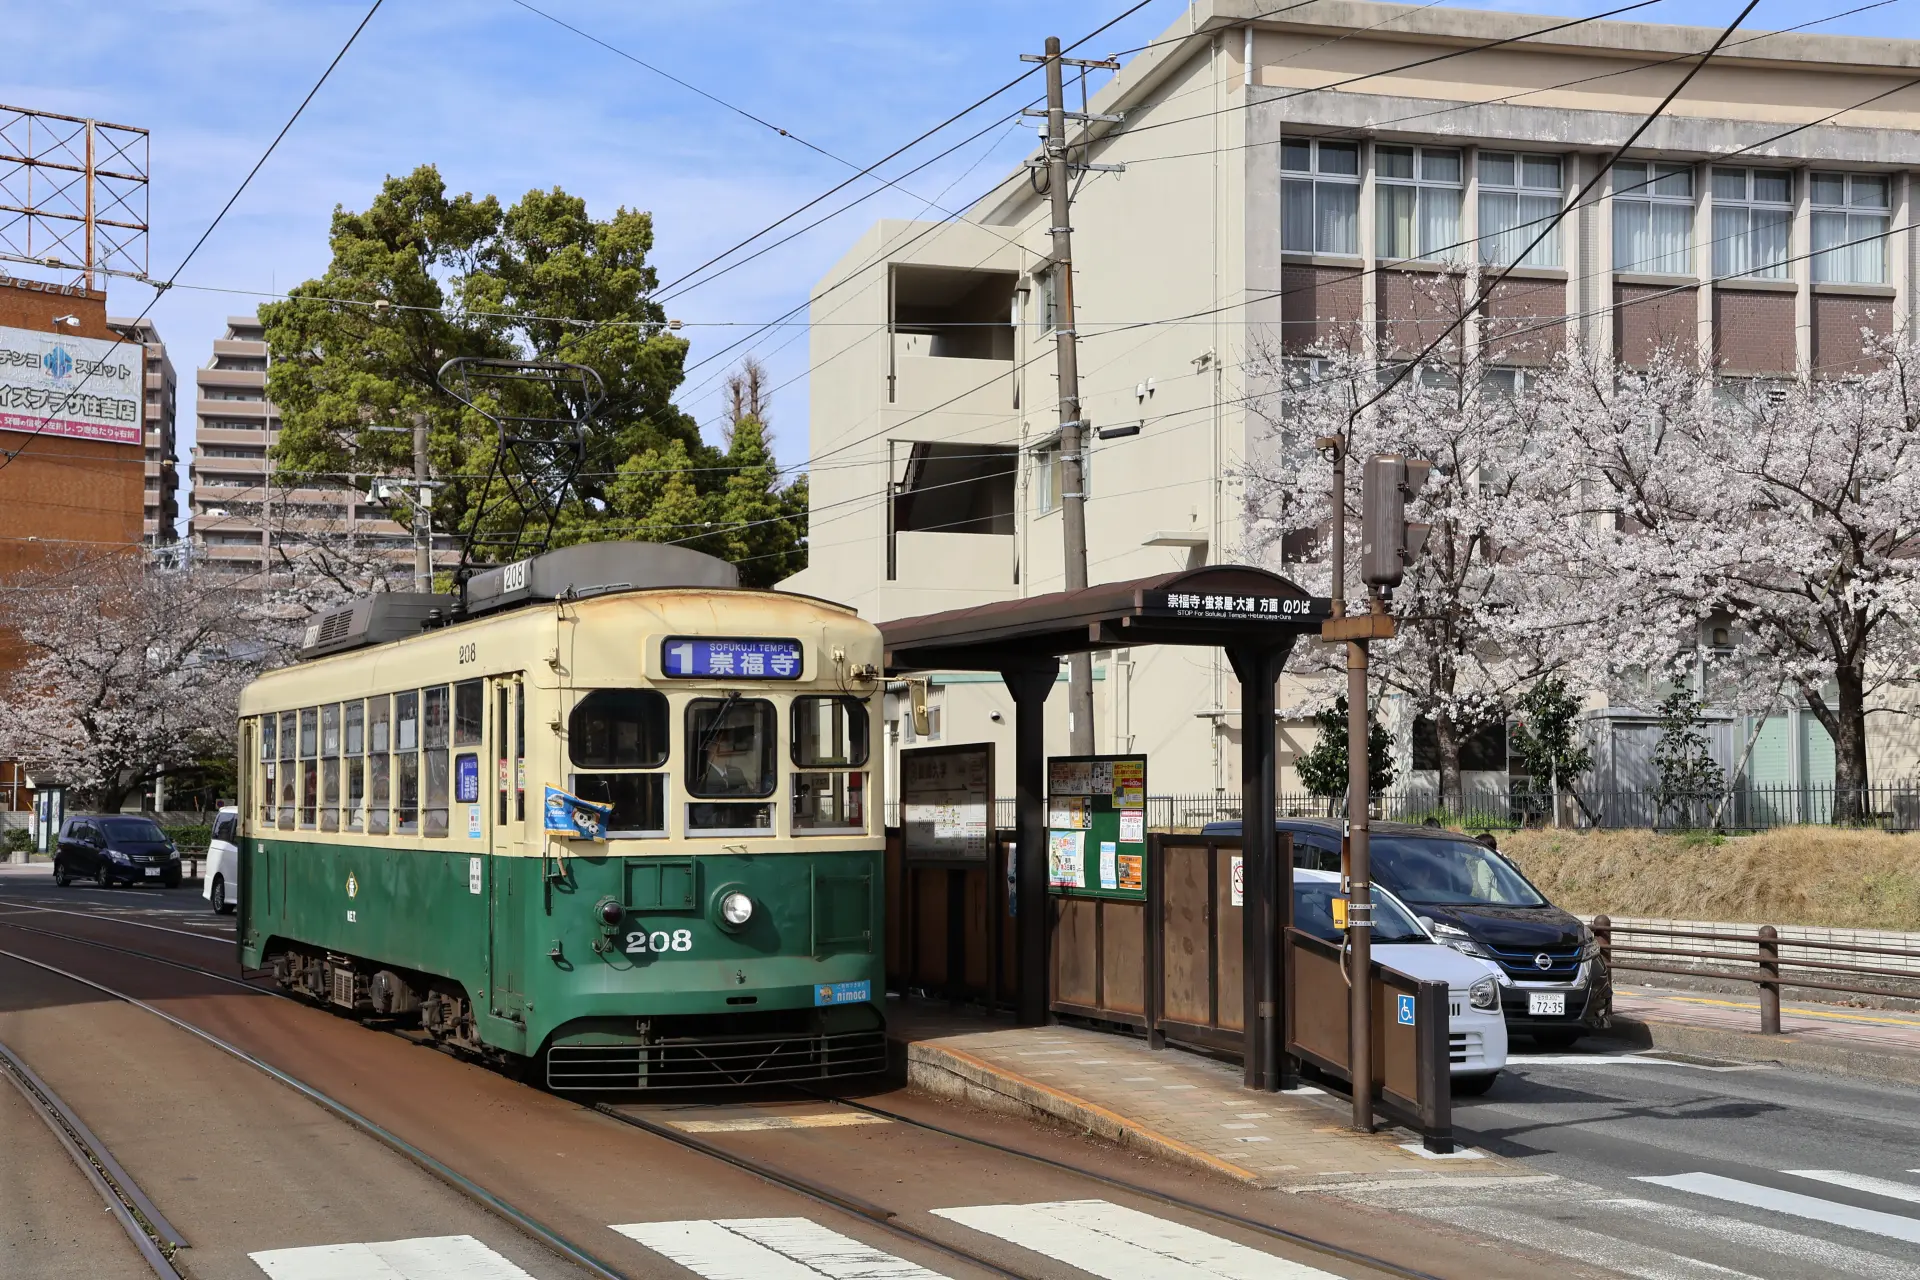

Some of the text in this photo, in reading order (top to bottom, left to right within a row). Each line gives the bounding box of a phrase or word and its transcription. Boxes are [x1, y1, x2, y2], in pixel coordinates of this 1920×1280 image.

[75, 359, 131, 380] スロット
[505, 562, 523, 590] 208
[1259, 597, 1279, 613] 方面
[1283, 599, 1311, 615] のりば
[459, 642, 476, 665] 208
[670, 643, 694, 675] 1
[709, 643, 794, 653] SOFUKUJI TEMPLE
[709, 652, 795, 676] 崇福寺
[625, 928, 693, 954] 208
[837, 989, 866, 1002] nimoca
[1537, 1002, 1563, 1012] 72-35
